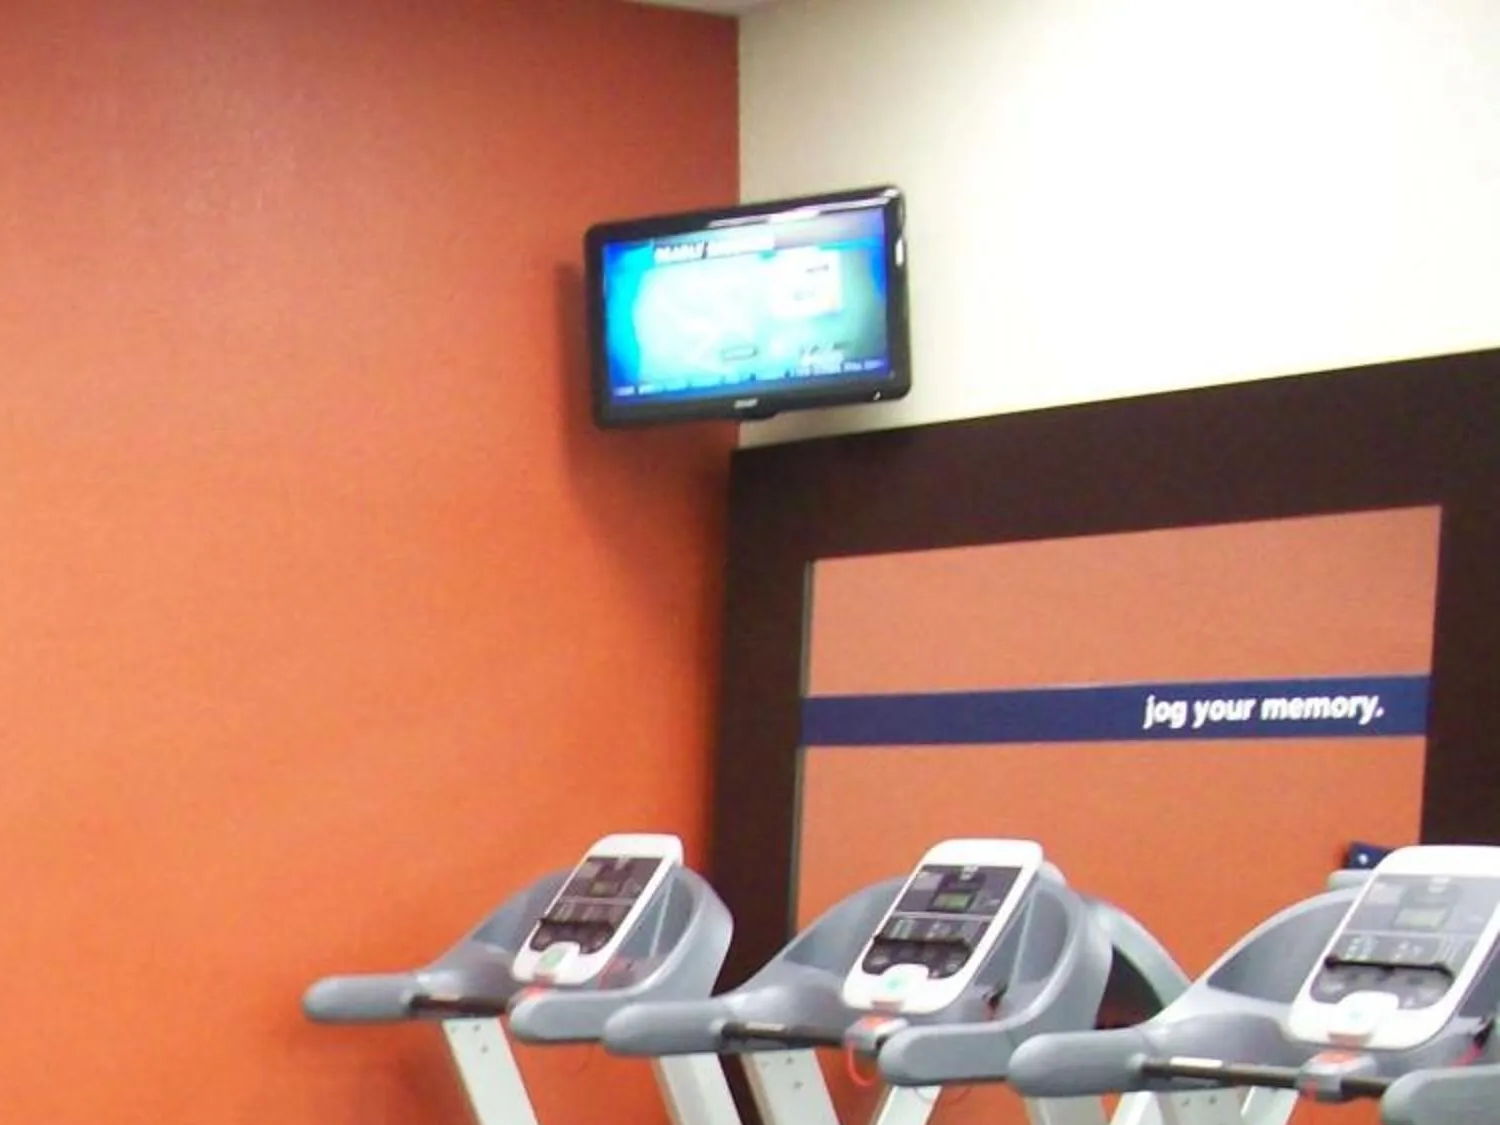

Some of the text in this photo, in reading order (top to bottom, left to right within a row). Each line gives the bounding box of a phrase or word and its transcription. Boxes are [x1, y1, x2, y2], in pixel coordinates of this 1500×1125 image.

[1143, 694, 1385, 729] jog your memory.
